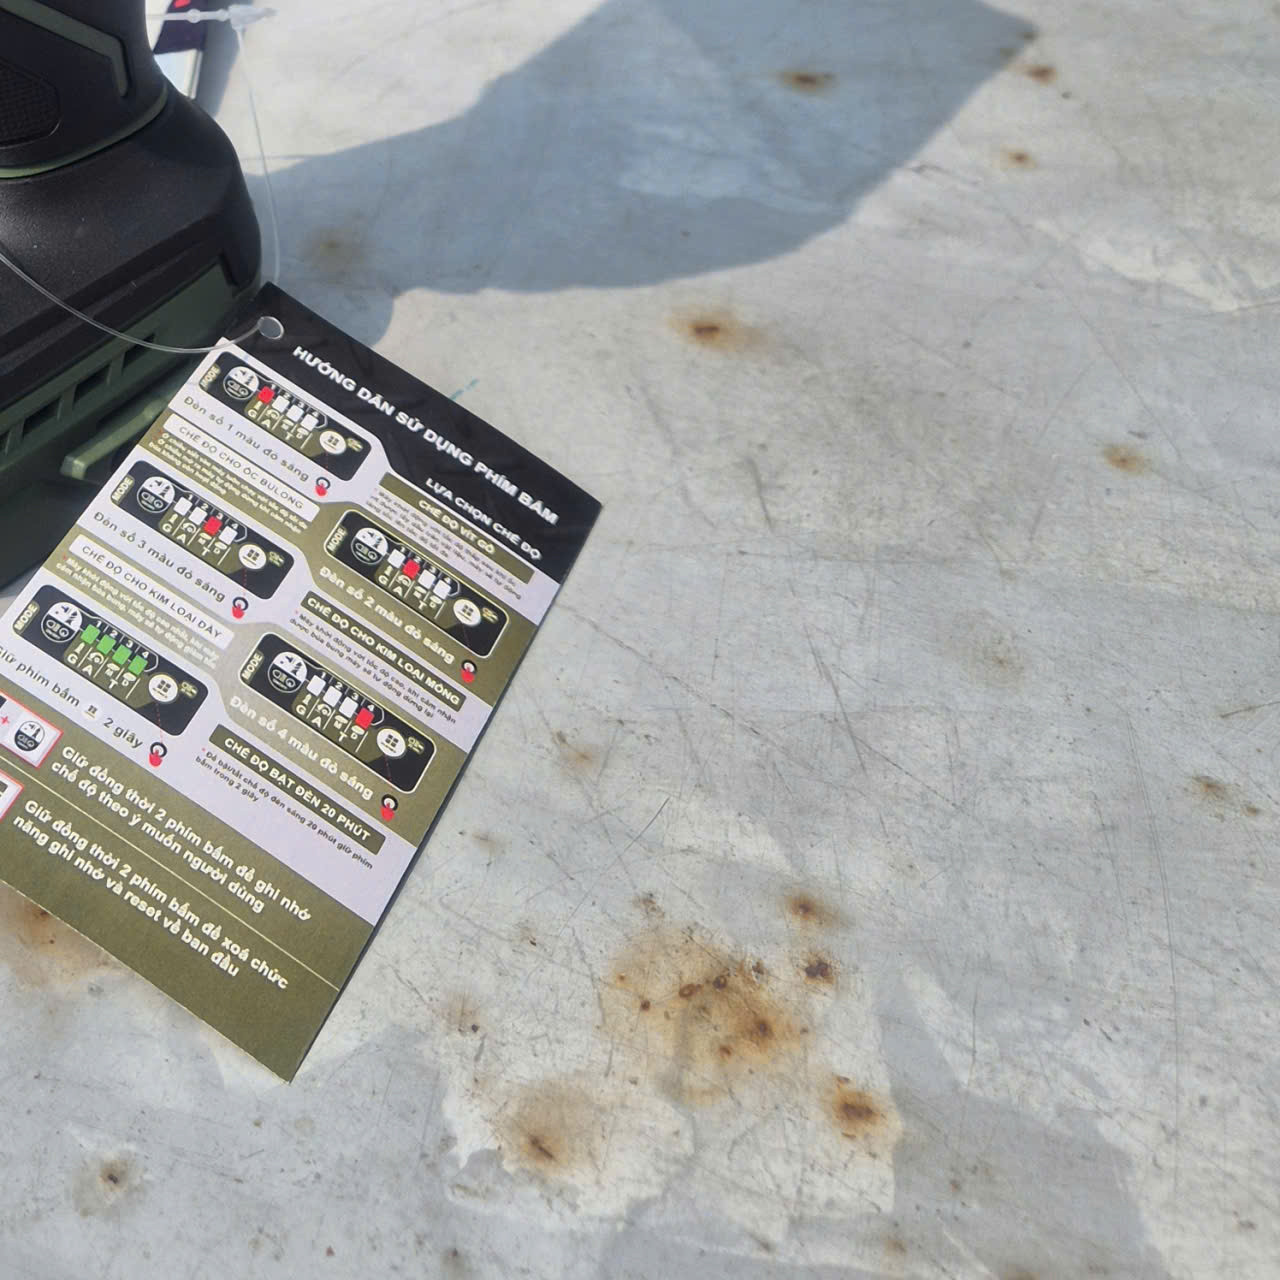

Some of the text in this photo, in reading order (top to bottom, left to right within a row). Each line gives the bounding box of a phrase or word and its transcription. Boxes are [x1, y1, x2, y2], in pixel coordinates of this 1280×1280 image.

[226, 422, 234, 431] 1
[292, 344, 357, 392] HƯỚNG
[394, 409, 425, 433] SỬ
[421, 427, 474, 467] DỤNG
[473, 459, 519, 497] PHÍM
[109, 476, 133, 502] MODE
[217, 450, 242, 469] CHO
[258, 476, 304, 510] BULONG
[453, 495, 492, 526] CHỌN
[136, 538, 147, 549] 3
[13, 603, 38, 631] MODE
[122, 571, 148, 591] CHO
[147, 587, 170, 605] KIM
[169, 601, 197, 624] LOẠI
[362, 595, 375, 608] 2
[240, 652, 263, 680] MODE
[349, 624, 376, 647] CHO
[374, 642, 398, 662] KIM
[395, 656, 425, 682] LOẠI
[102, 716, 114, 729] 2
[275, 727, 289, 740] 4
[337, 769, 374, 801] sáng
[50, 760, 266, 914] chế độ theo ý muốn người dùng
[60, 744, 90, 769] Giữ
[87, 763, 126, 796] đồng
[123, 787, 156, 814] thời
[153, 807, 167, 821] 2
[163, 815, 202, 847] phím
[201, 838, 235, 869] bấm
[252, 877, 281, 901] ghi
[279, 894, 312, 922] nhớ
[319, 802, 336, 818] 20
[335, 812, 371, 841] PHÚT
[11, 814, 50, 847] năng
[46, 839, 75, 862] ghi
[72, 854, 106, 882] nhớ
[104, 875, 124, 896] và
[122, 889, 162, 922] reset
[180, 927, 210, 956] ban
[209, 948, 241, 977] đầu
[23, 798, 53, 824] Giữ
[50, 817, 90, 851] đồng
[88, 842, 121, 870] thời
[118, 862, 132, 878] 2
[128, 871, 168, 904] phím
[167, 895, 201, 926] bấm
[249, 955, 289, 989] chức
